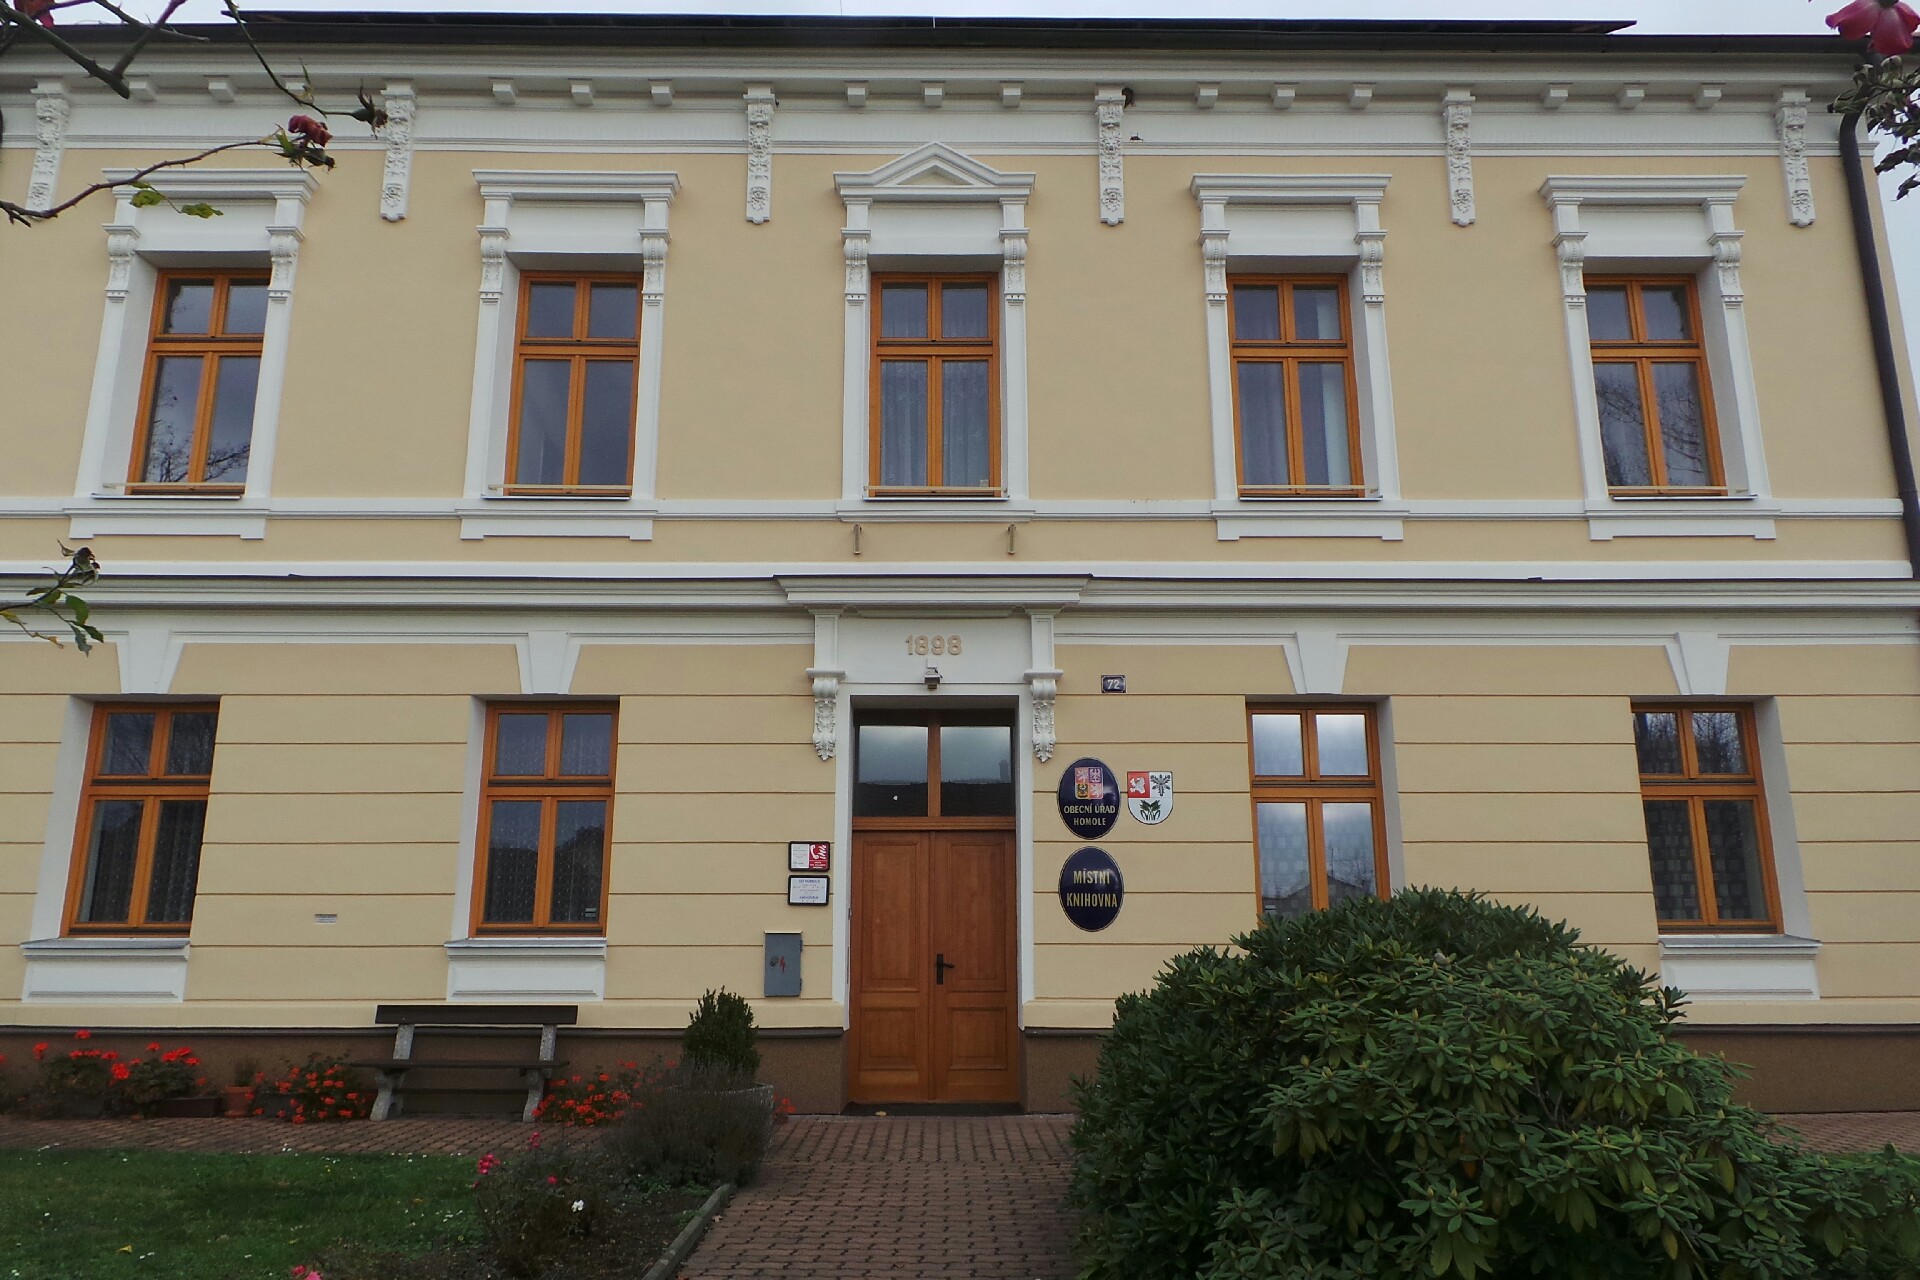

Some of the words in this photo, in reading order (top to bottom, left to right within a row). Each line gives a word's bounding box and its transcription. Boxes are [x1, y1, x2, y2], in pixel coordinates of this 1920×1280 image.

[905, 634, 962, 656] 1898
[1107, 679, 1121, 690] 72
[1064, 804, 1092, 814] OBECNÍ
[1095, 803, 1115, 814] ÚŘAD
[1073, 817, 1106, 826] HOMOLE
[1073, 868, 1110, 884] MÍSTNÍ
[1066, 893, 1118, 908] KNIHOVNA
